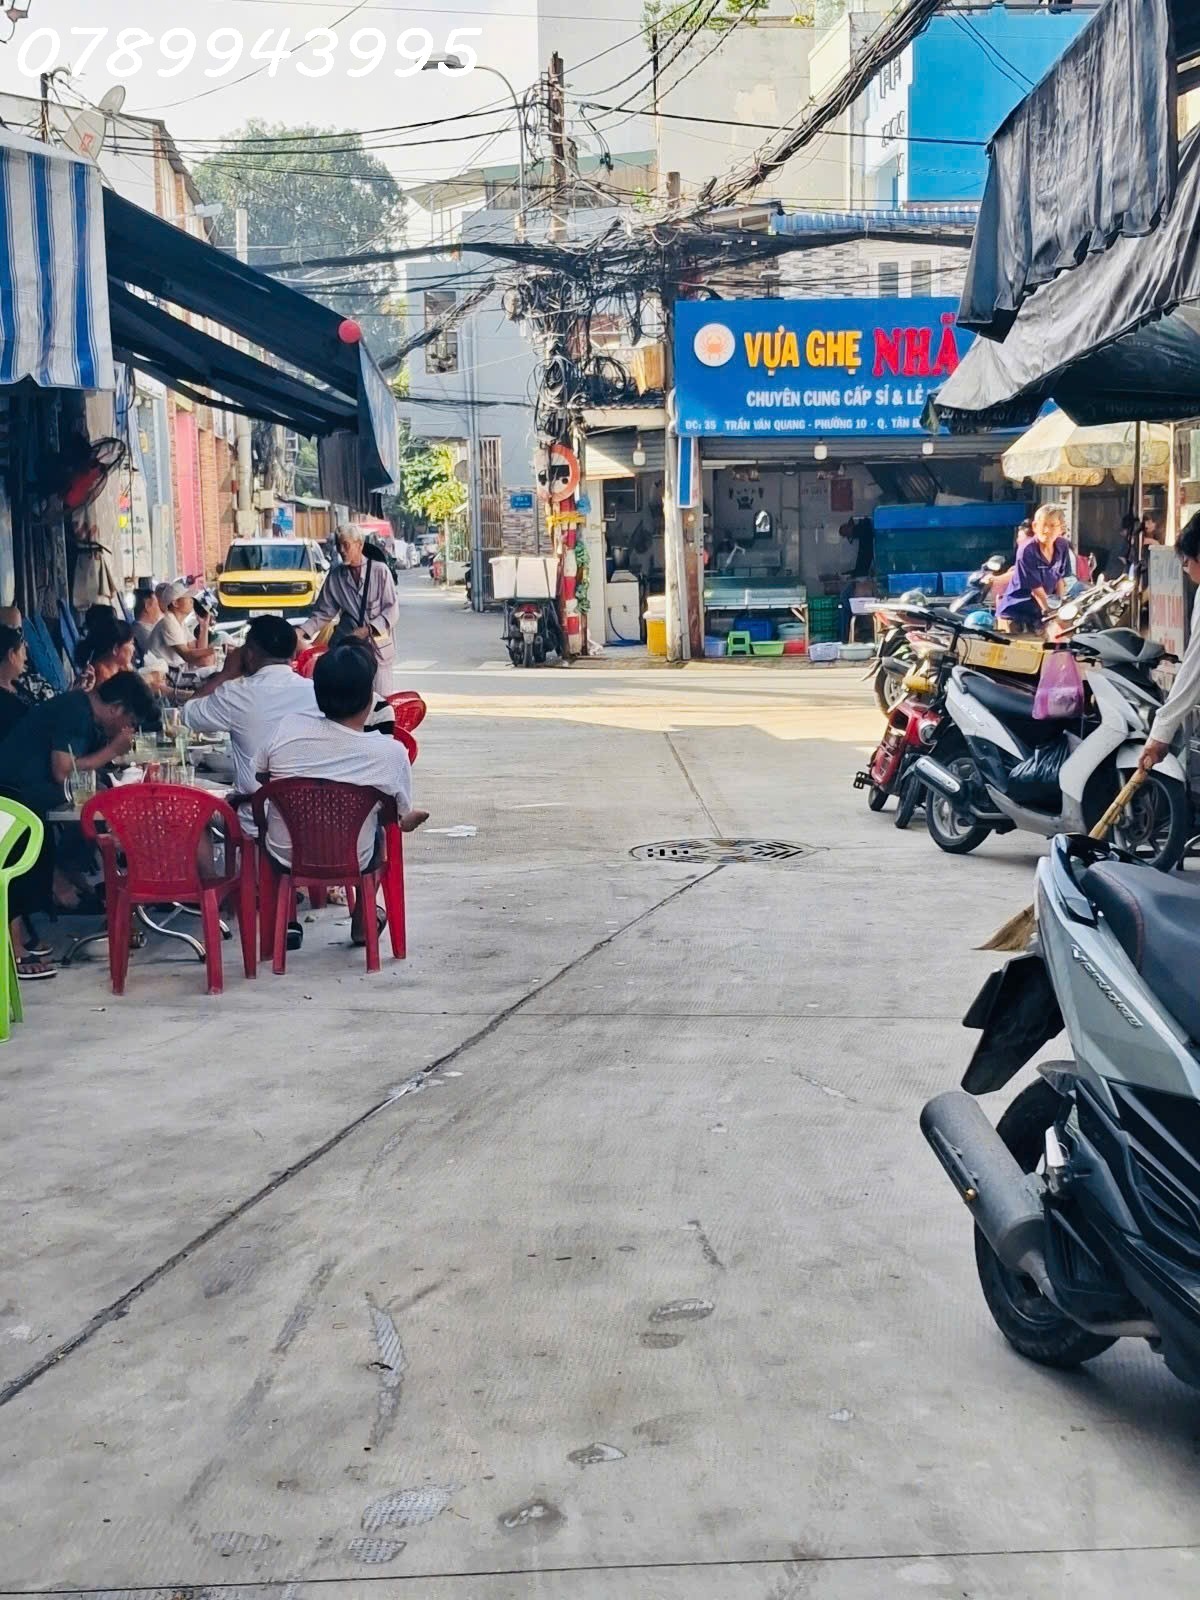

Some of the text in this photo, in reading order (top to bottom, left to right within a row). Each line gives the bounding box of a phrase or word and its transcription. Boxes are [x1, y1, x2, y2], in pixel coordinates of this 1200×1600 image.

[743, 324, 800, 377] VỰA
[805, 330, 863, 376] GHẸ
[746, 387, 801, 407] CHUYÊN
[803, 390, 841, 407] CUNG
[843, 384, 872, 407] CẤP
[875, 384, 890, 406] SỈ
[891, 391, 904, 406] &
[906, 383, 924, 406] LẺ
[773, 419, 806, 431] QUANG
[855, 419, 867, 429] 10
